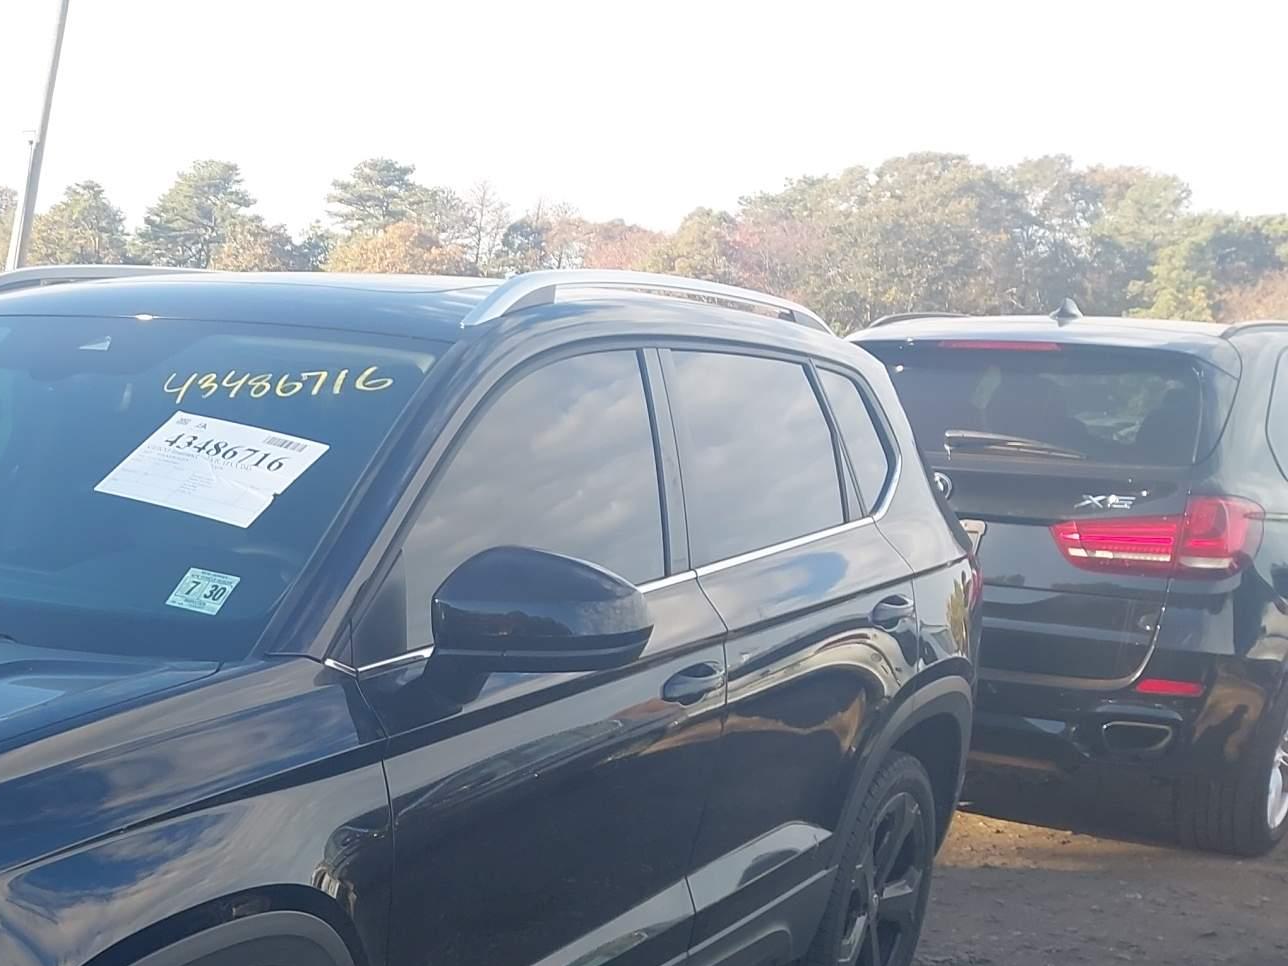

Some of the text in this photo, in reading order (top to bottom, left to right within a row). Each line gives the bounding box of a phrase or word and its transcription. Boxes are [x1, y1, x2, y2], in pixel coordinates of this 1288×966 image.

[163, 365, 394, 405] 43486716
[164, 432, 291, 473] 43486716
[184, 580, 228, 602] 7 30
